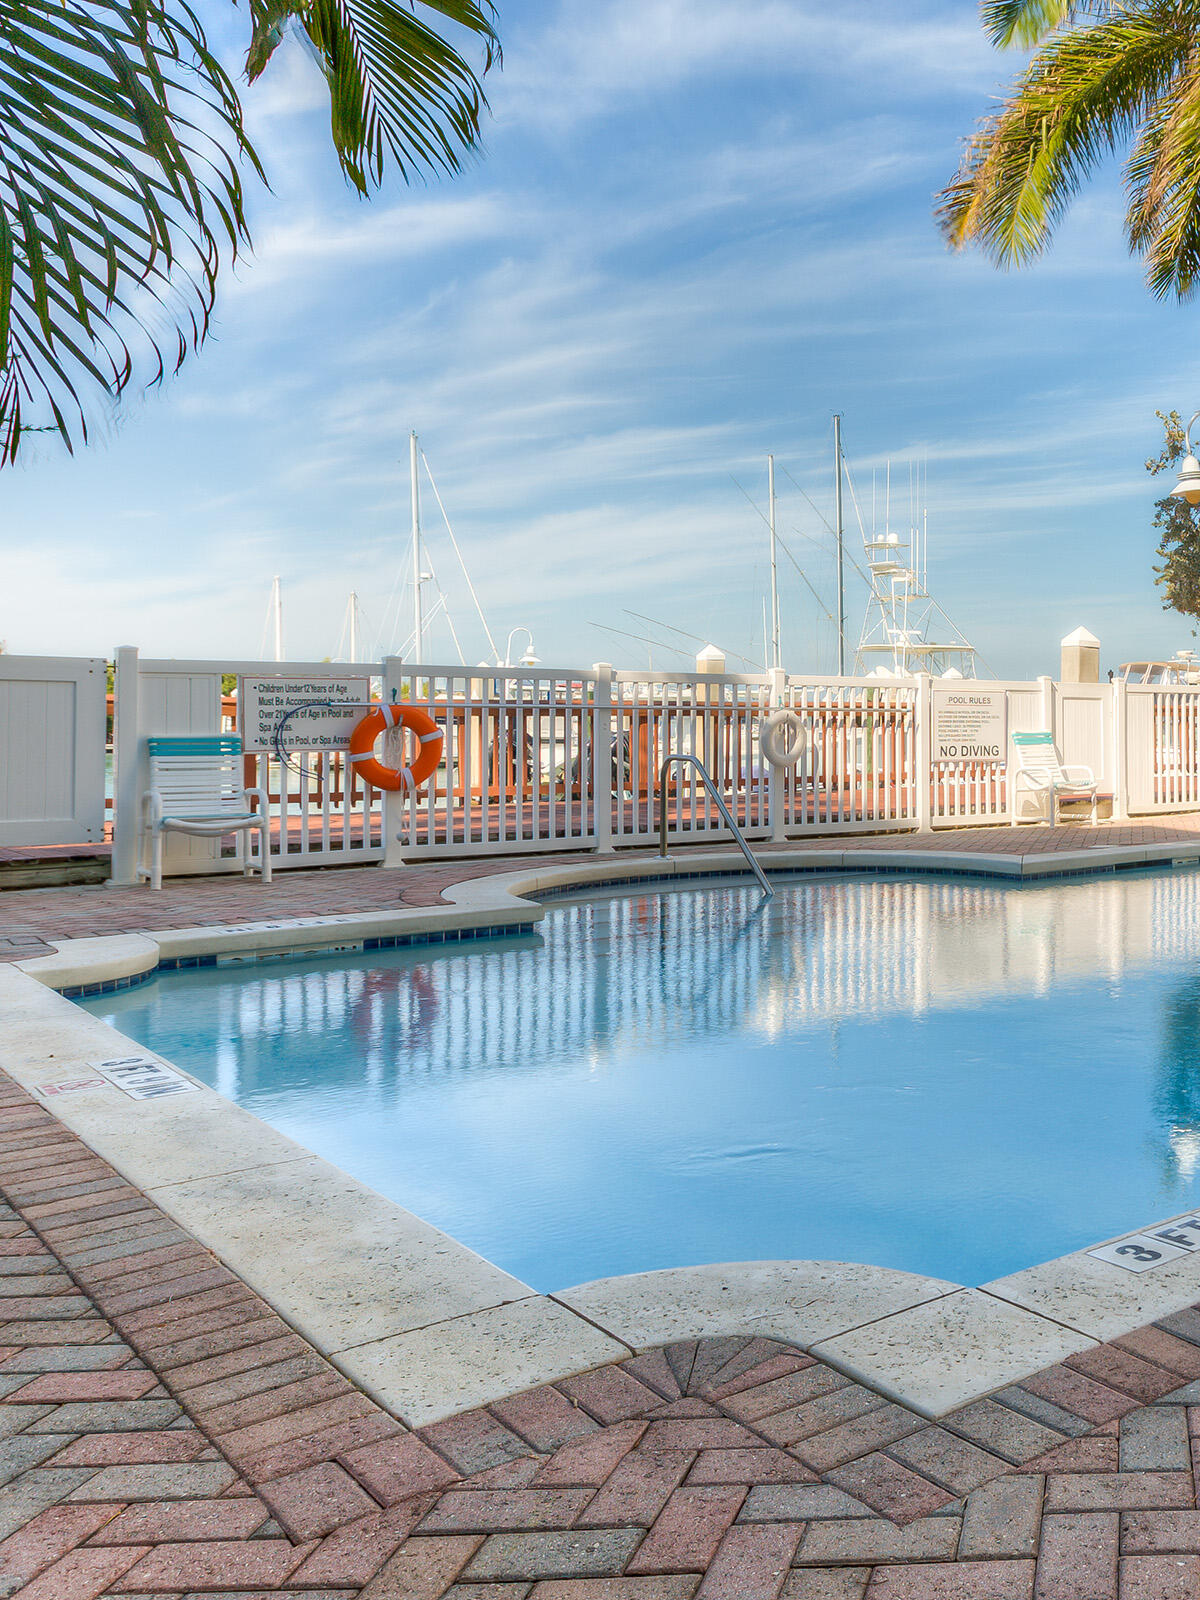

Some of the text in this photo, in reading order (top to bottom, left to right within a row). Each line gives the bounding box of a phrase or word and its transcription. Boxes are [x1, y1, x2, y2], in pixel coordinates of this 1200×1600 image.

[258, 684, 284, 693] Children
[285, 684, 303, 693] Under
[310, 684, 327, 693] Years
[328, 684, 335, 693] of
[336, 684, 347, 695] Age
[258, 697, 274, 706] Must
[276, 697, 284, 706] Be
[948, 696, 968, 704] POOL
[258, 710, 274, 719] Over
[300, 710, 307, 719] of
[308, 710, 321, 720] Age
[322, 710, 327, 719] in
[328, 710, 341, 719] Pool
[342, 710, 353, 719] and
[259, 723, 293, 734] Spa Aas.
[259, 737, 268, 745] No
[269, 737, 287, 746] Gass
[288, 737, 294, 745] in
[319, 736, 331, 747] Spa
[940, 745, 1000, 757] NO DIVING
[1115, 1244, 1162, 1262] 3
